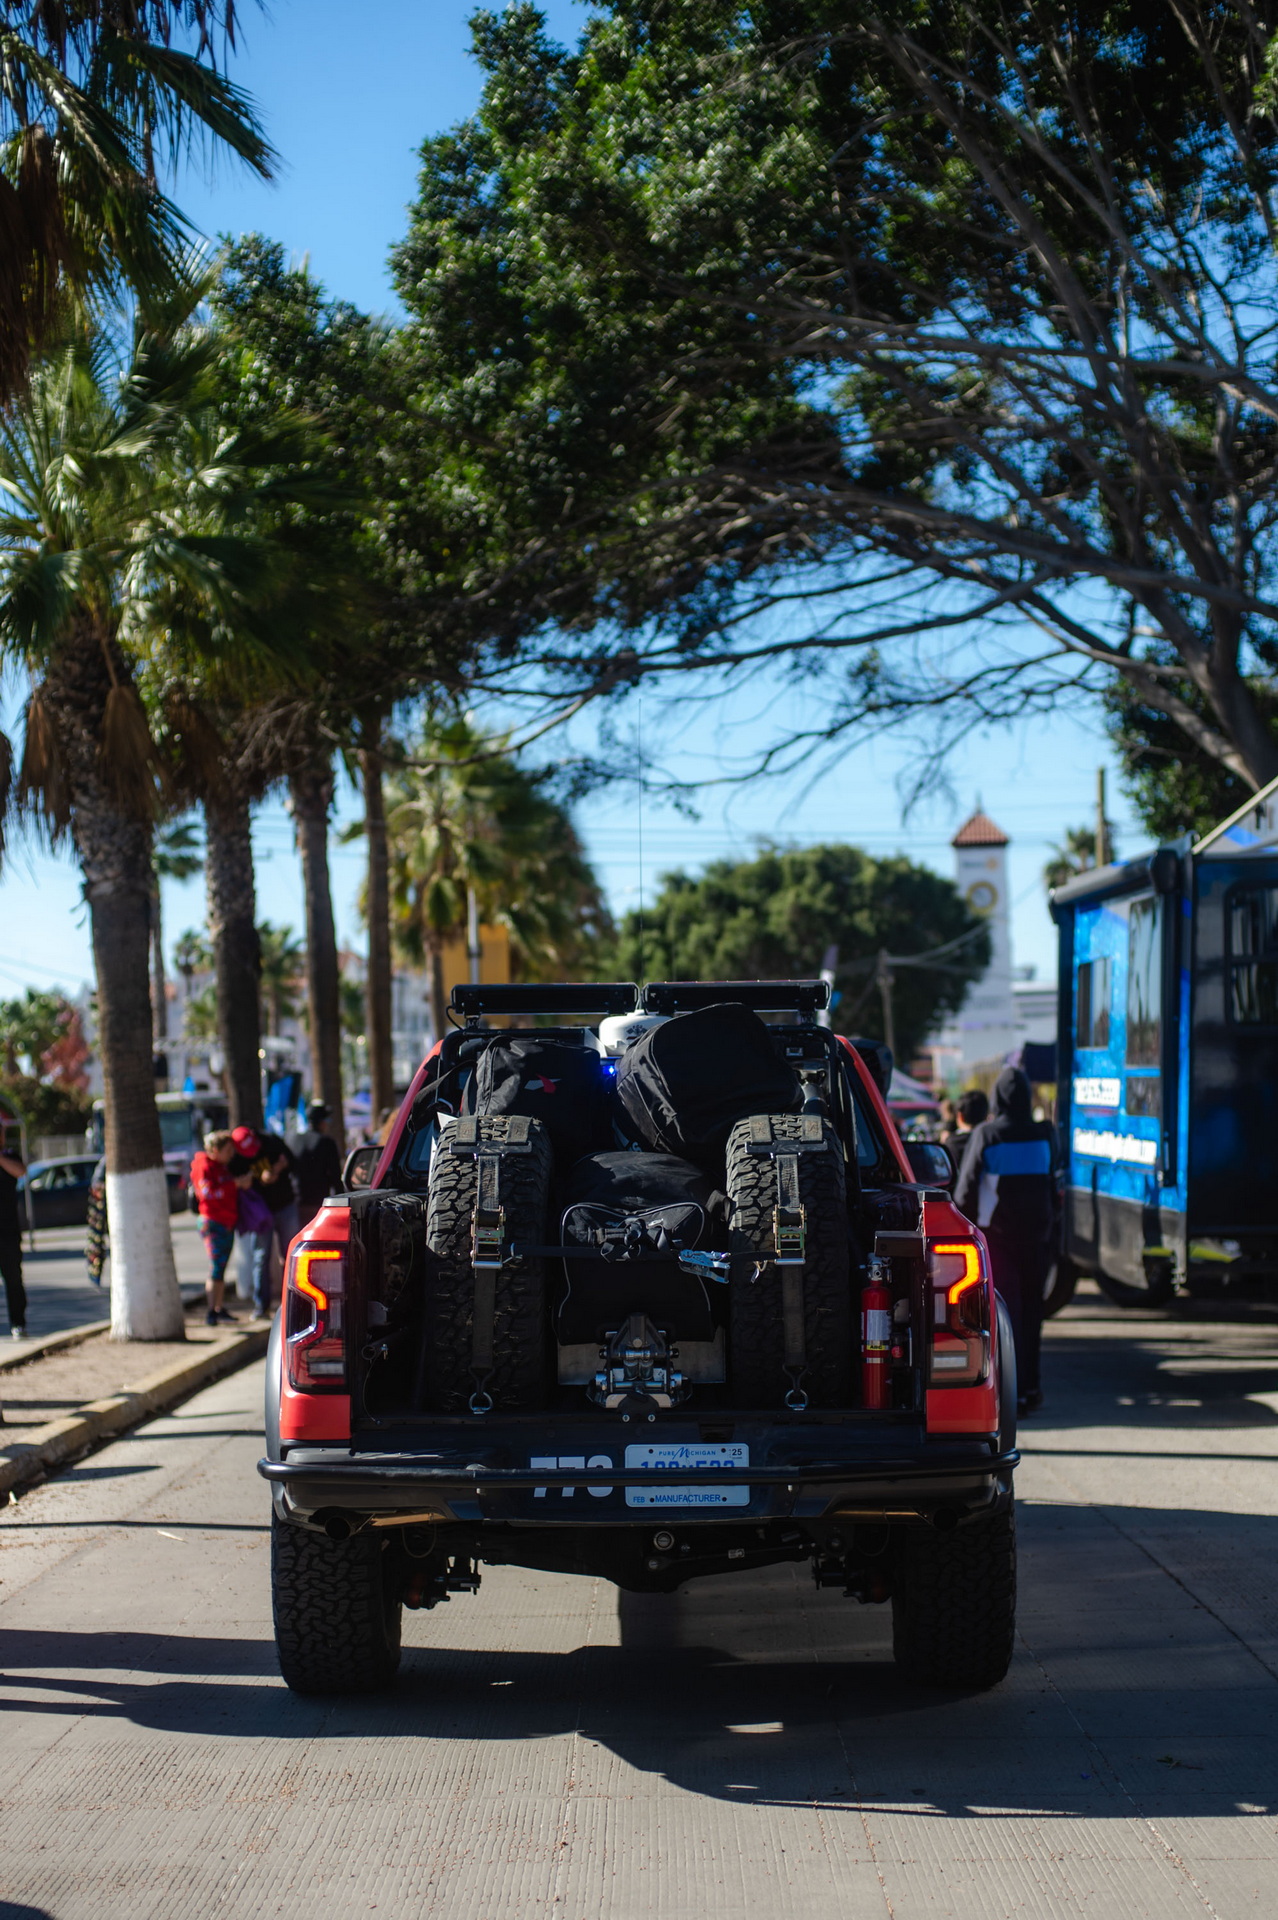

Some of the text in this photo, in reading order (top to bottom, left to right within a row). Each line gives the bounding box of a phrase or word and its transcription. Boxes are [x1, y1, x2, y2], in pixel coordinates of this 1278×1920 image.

[672, 1446, 716, 1460] MICHIGAN
[732, 1448, 743, 1456] 25
[655, 1494, 721, 1503] MANUFACTURER
